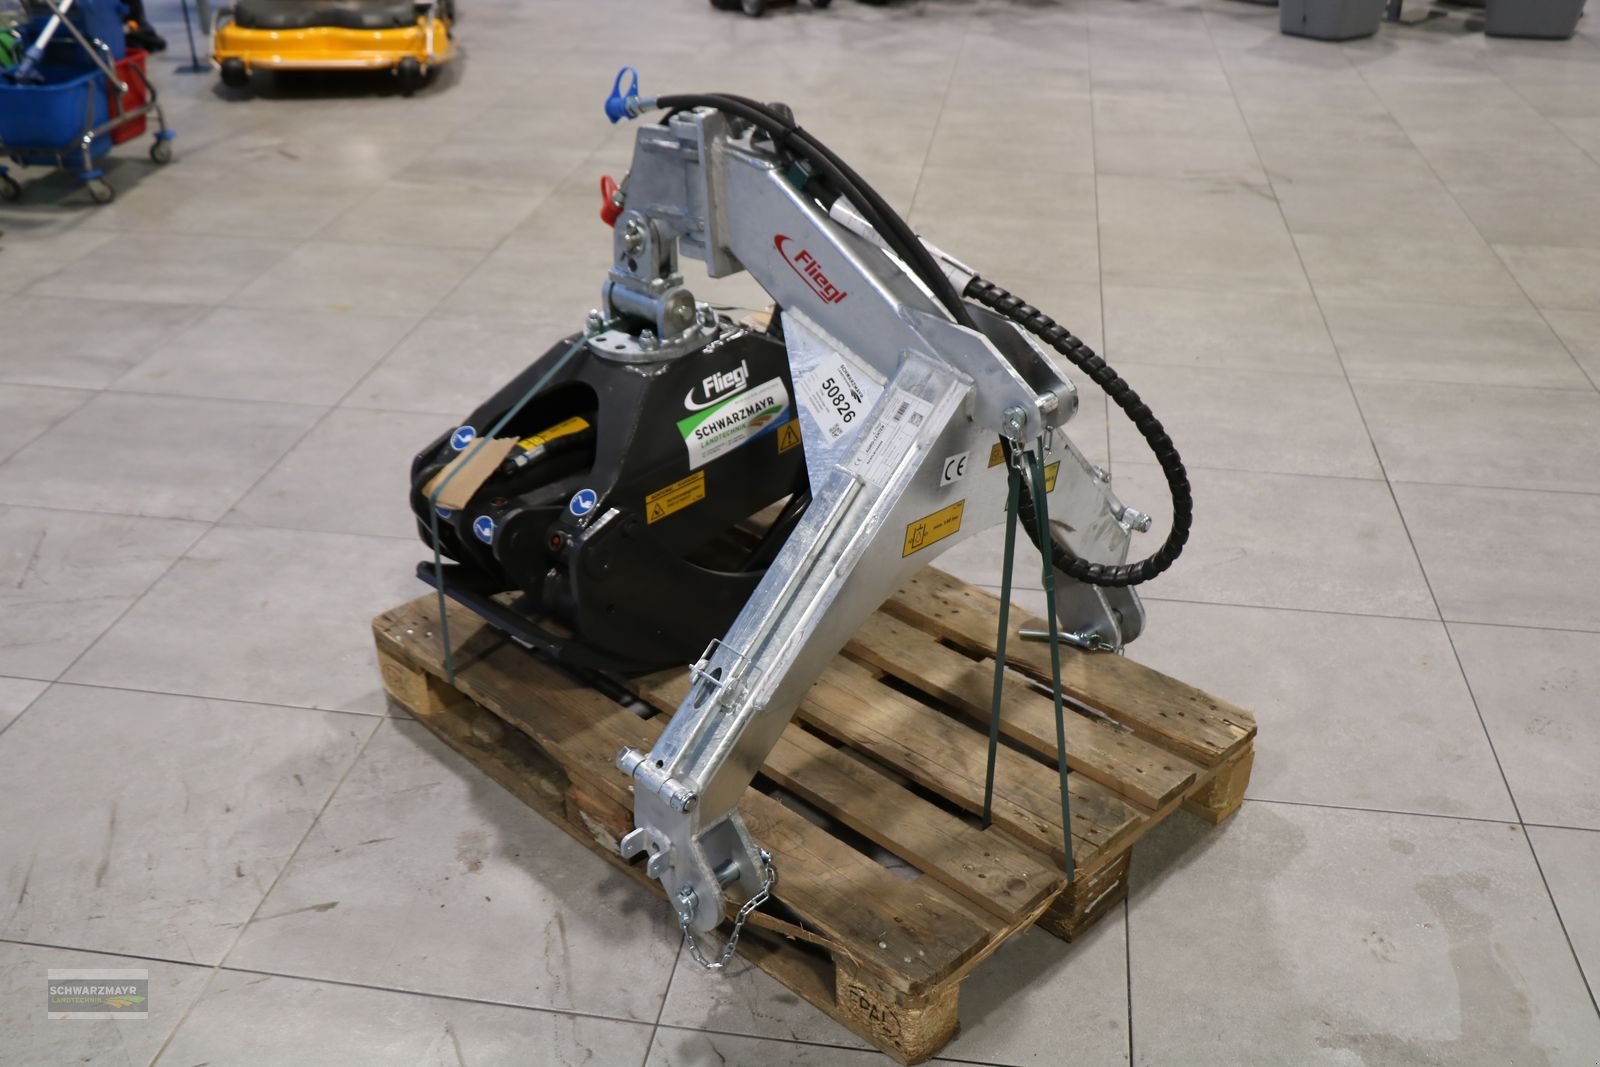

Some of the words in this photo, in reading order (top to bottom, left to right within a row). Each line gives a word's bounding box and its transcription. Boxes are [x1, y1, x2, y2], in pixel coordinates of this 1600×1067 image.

[793, 249, 848, 304] Fliegl
[702, 359, 749, 399] Fliegl
[822, 377, 856, 423] 50826
[695, 396, 775, 440] SCHWARZMAYR
[701, 423, 748, 449] LANDTECHNIK
[944, 456, 967, 481] CE
